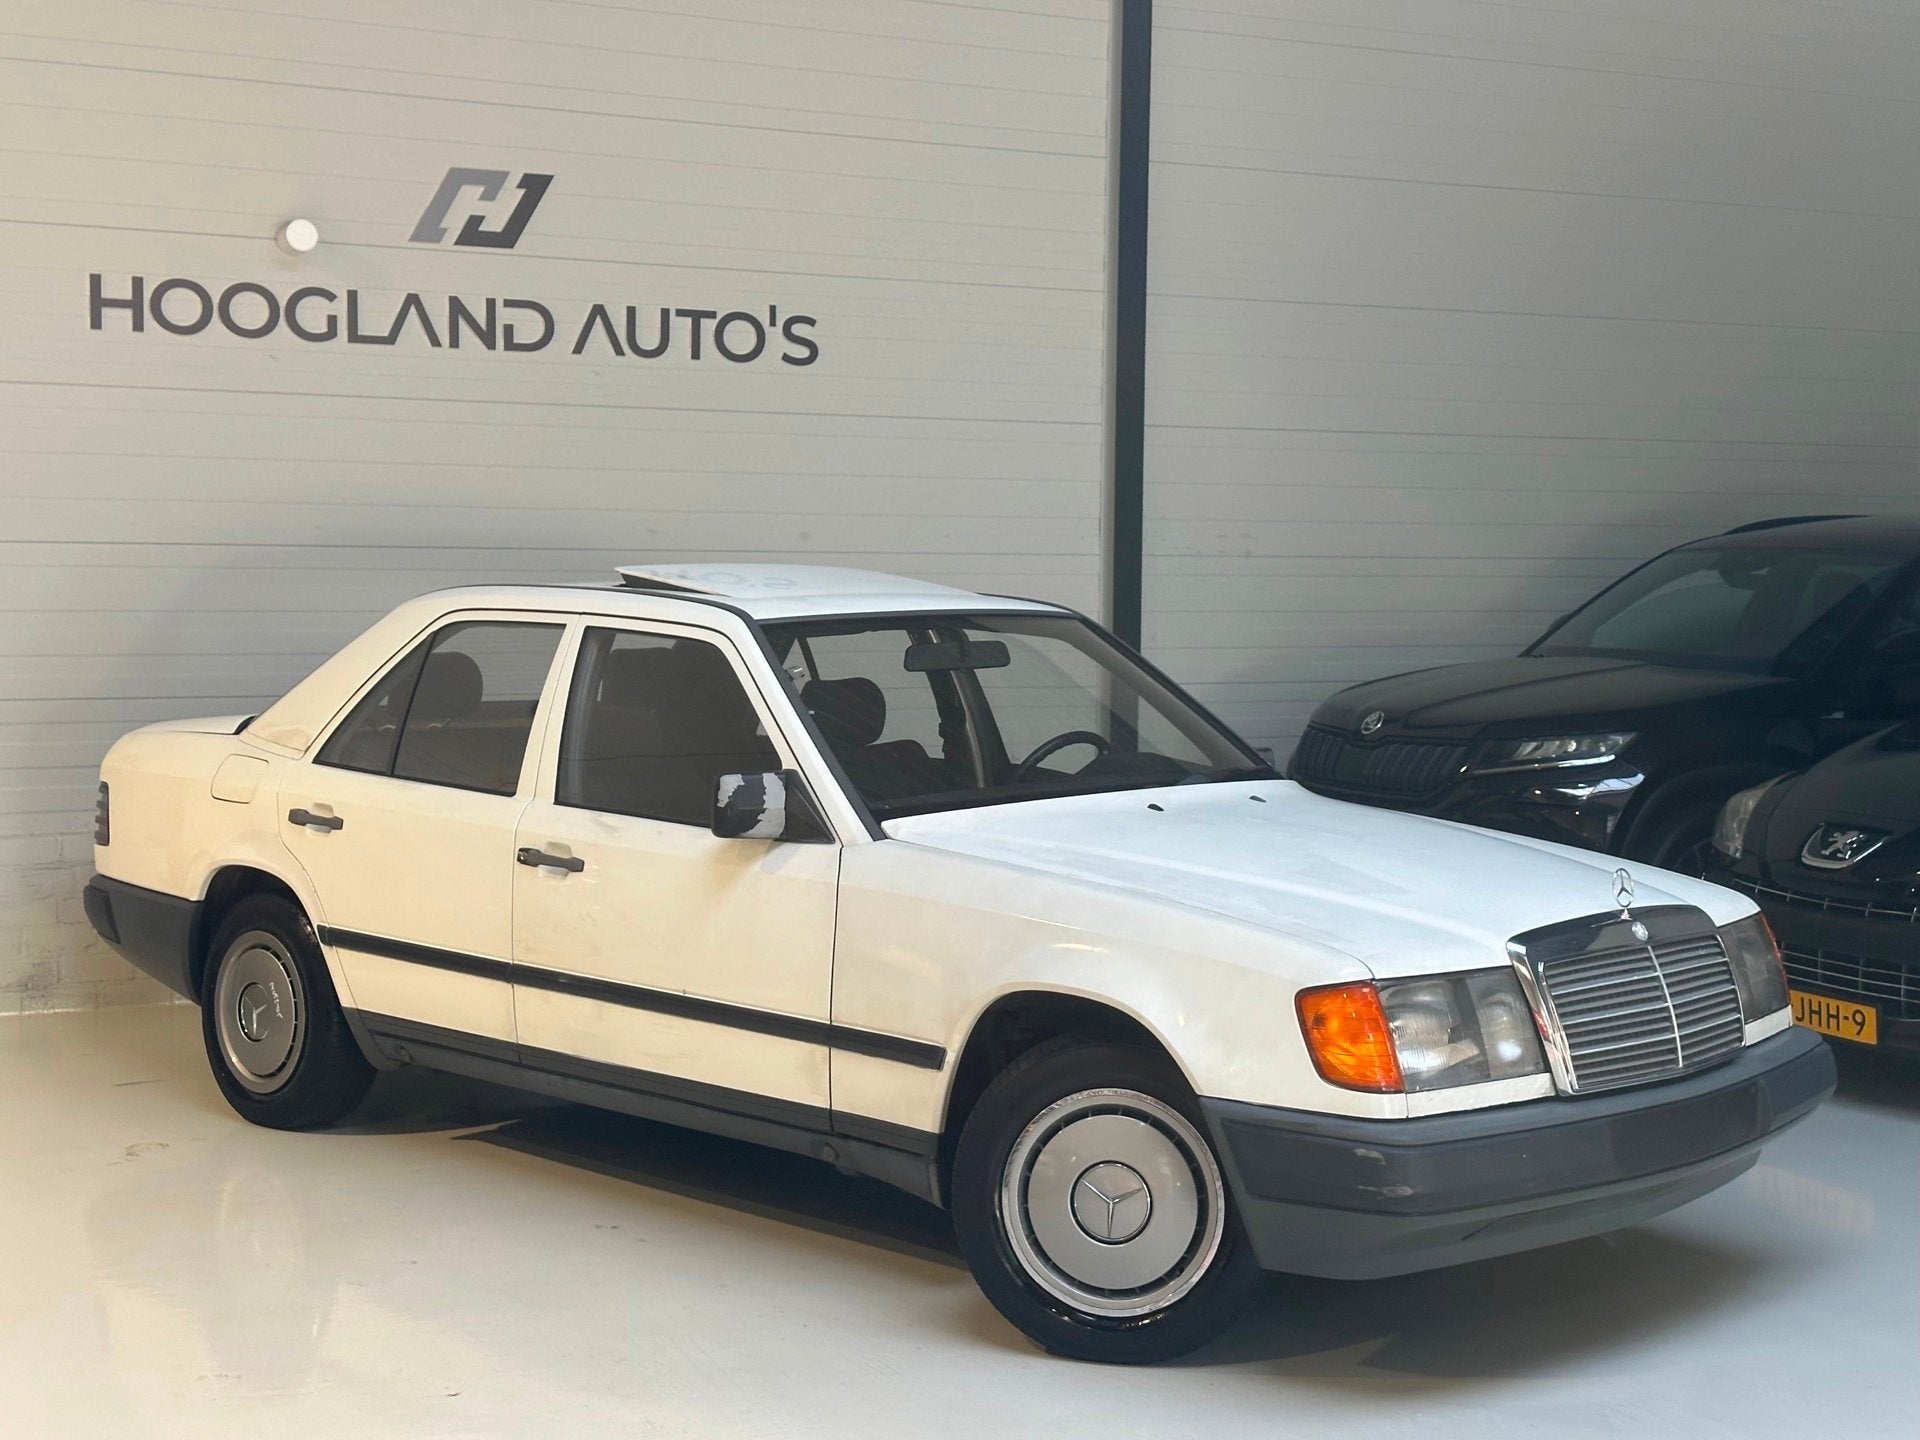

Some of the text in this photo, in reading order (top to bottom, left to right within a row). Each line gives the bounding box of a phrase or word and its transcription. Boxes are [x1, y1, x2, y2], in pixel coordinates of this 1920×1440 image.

[89, 273, 819, 366] HOOGLAND AUTO'S
[1791, 997, 1866, 1036] JHH-9
